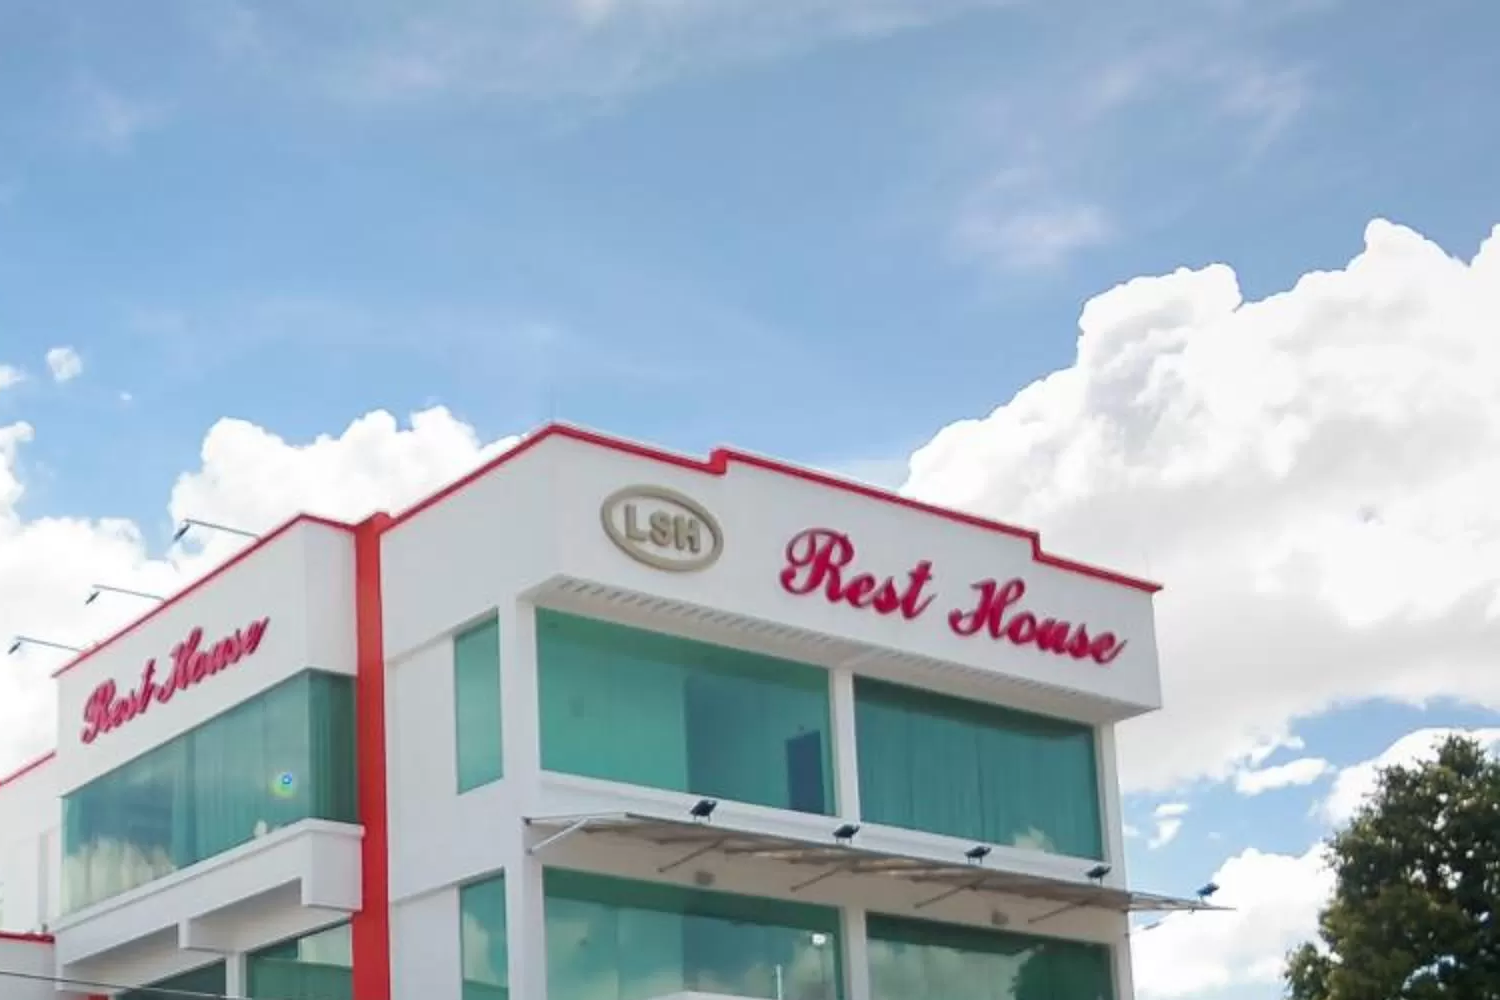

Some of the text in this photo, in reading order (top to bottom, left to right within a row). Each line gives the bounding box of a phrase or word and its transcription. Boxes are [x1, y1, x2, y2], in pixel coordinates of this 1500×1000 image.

[624, 503, 701, 554] LSH
[779, 527, 1128, 665] Rest House
[81, 615, 271, 744] Rest House
